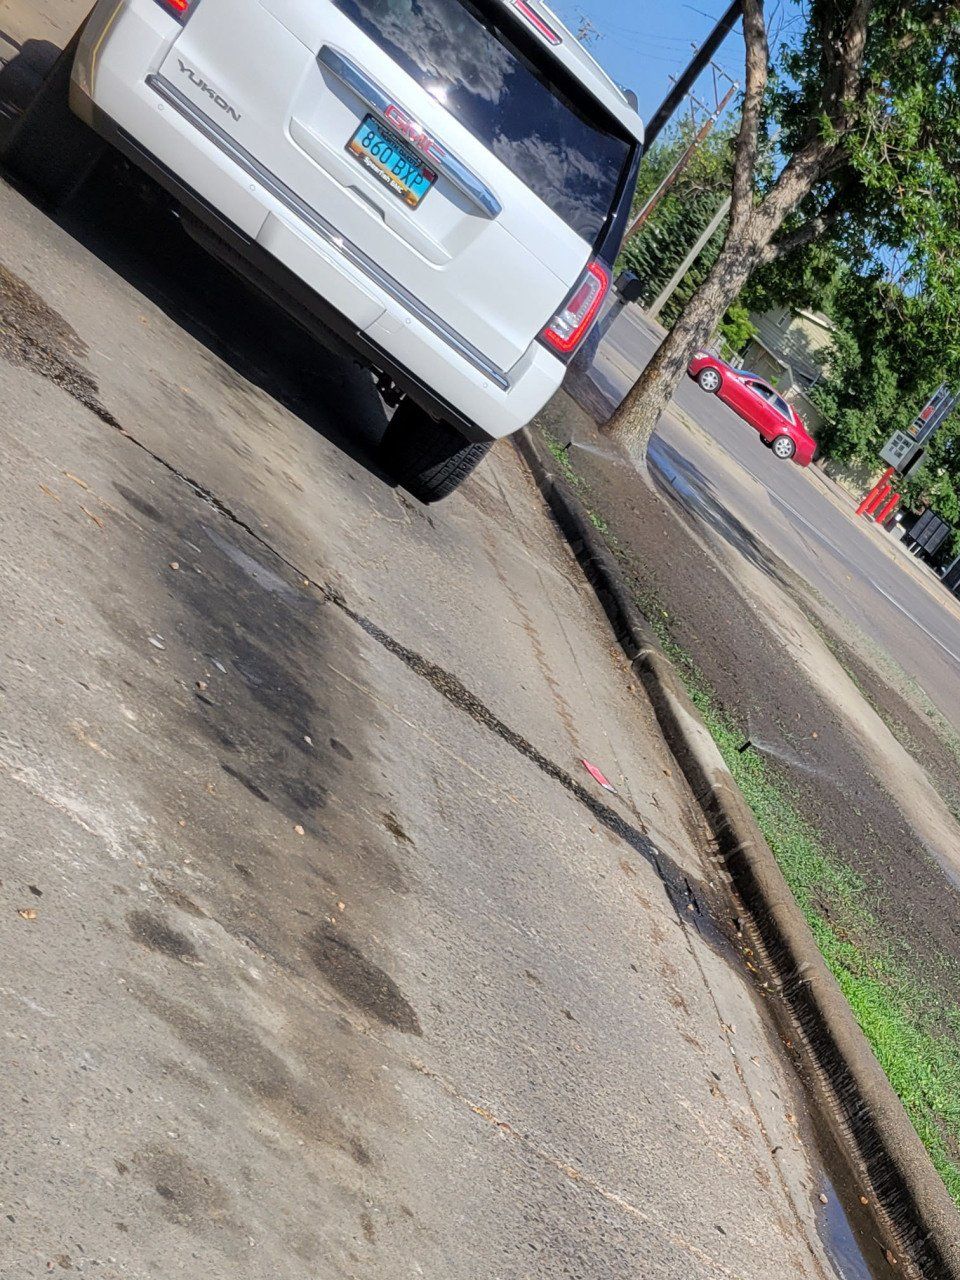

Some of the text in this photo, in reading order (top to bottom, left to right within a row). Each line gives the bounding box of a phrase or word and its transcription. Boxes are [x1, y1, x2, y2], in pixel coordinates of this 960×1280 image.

[178, 58, 241, 121] YUKON
[362, 131, 393, 164] 860
[391, 159, 424, 188] BXP
[385, 104, 447, 163] GMC
